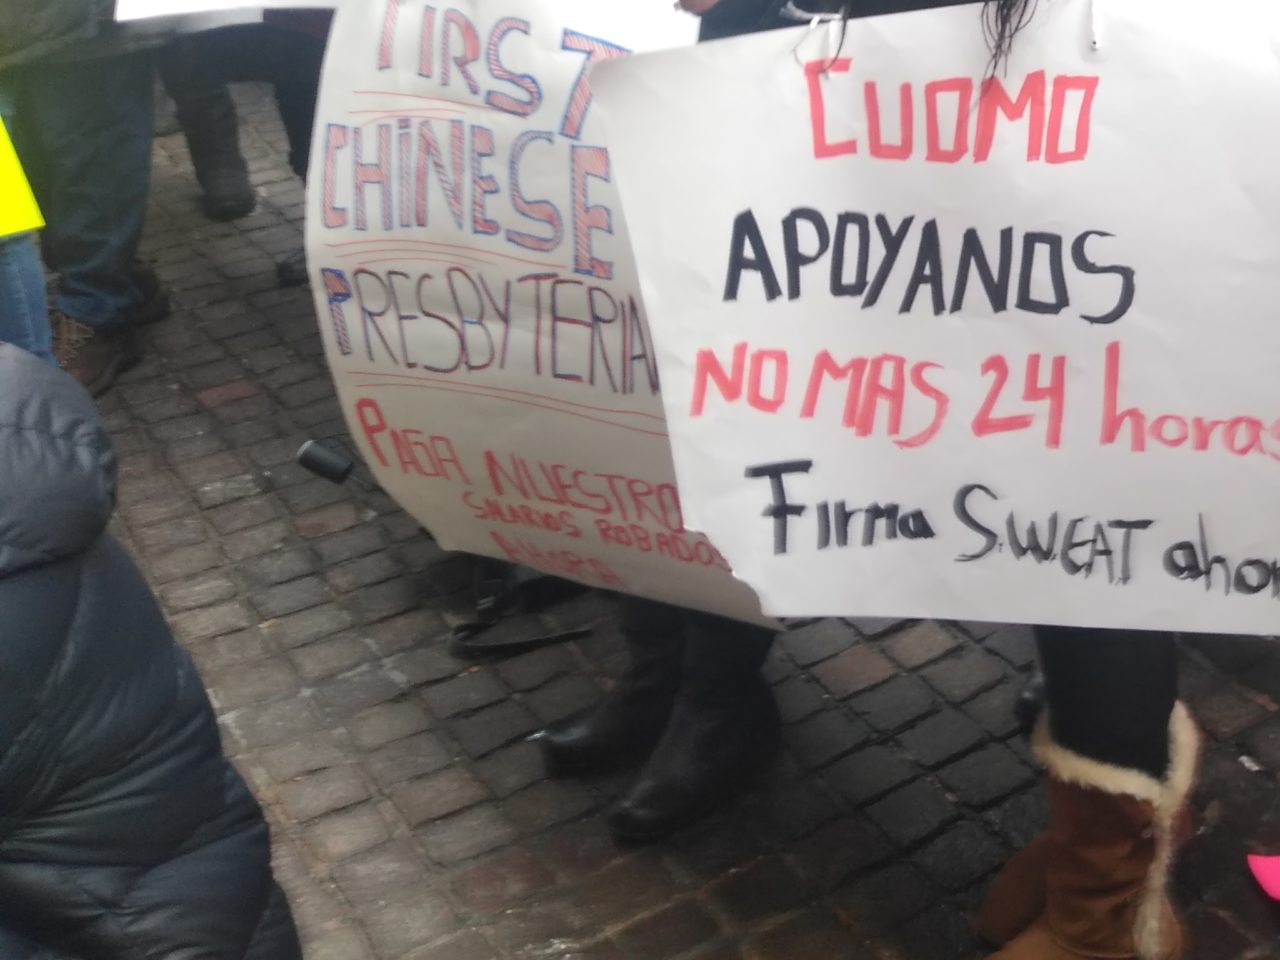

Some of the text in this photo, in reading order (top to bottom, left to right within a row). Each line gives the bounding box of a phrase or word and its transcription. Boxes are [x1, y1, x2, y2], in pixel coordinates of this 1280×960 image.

[803, 57, 1099, 165] CUOMO
[723, 207, 1136, 325] APOYANOS
[354, 397, 472, 486] PAGA
[688, 342, 789, 417] NO
[800, 349, 950, 449] MAS
[970, 353, 1066, 449] 24
[463, 490, 581, 538] SALARIOS
